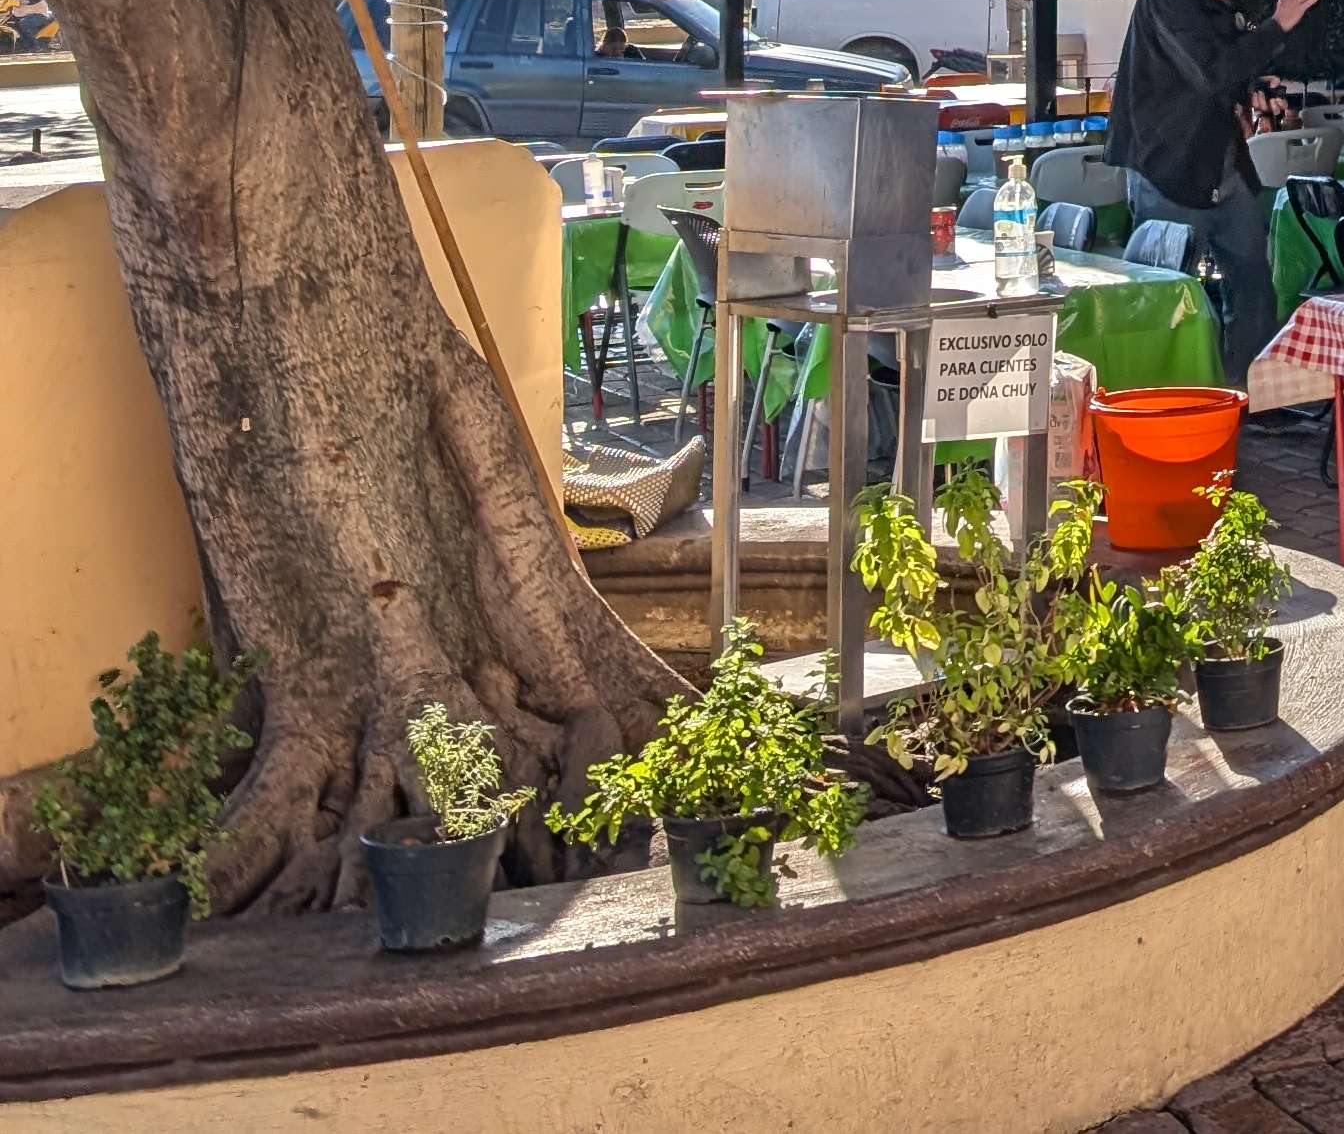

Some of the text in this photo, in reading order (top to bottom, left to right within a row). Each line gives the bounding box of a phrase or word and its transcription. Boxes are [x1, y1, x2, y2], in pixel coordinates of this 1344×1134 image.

[939, 332, 1048, 351] EXCLUSIVO SOLO
[939, 358, 1037, 377] PARA CLIENTES
[937, 382, 1037, 402] DE DOÑA CHUY
